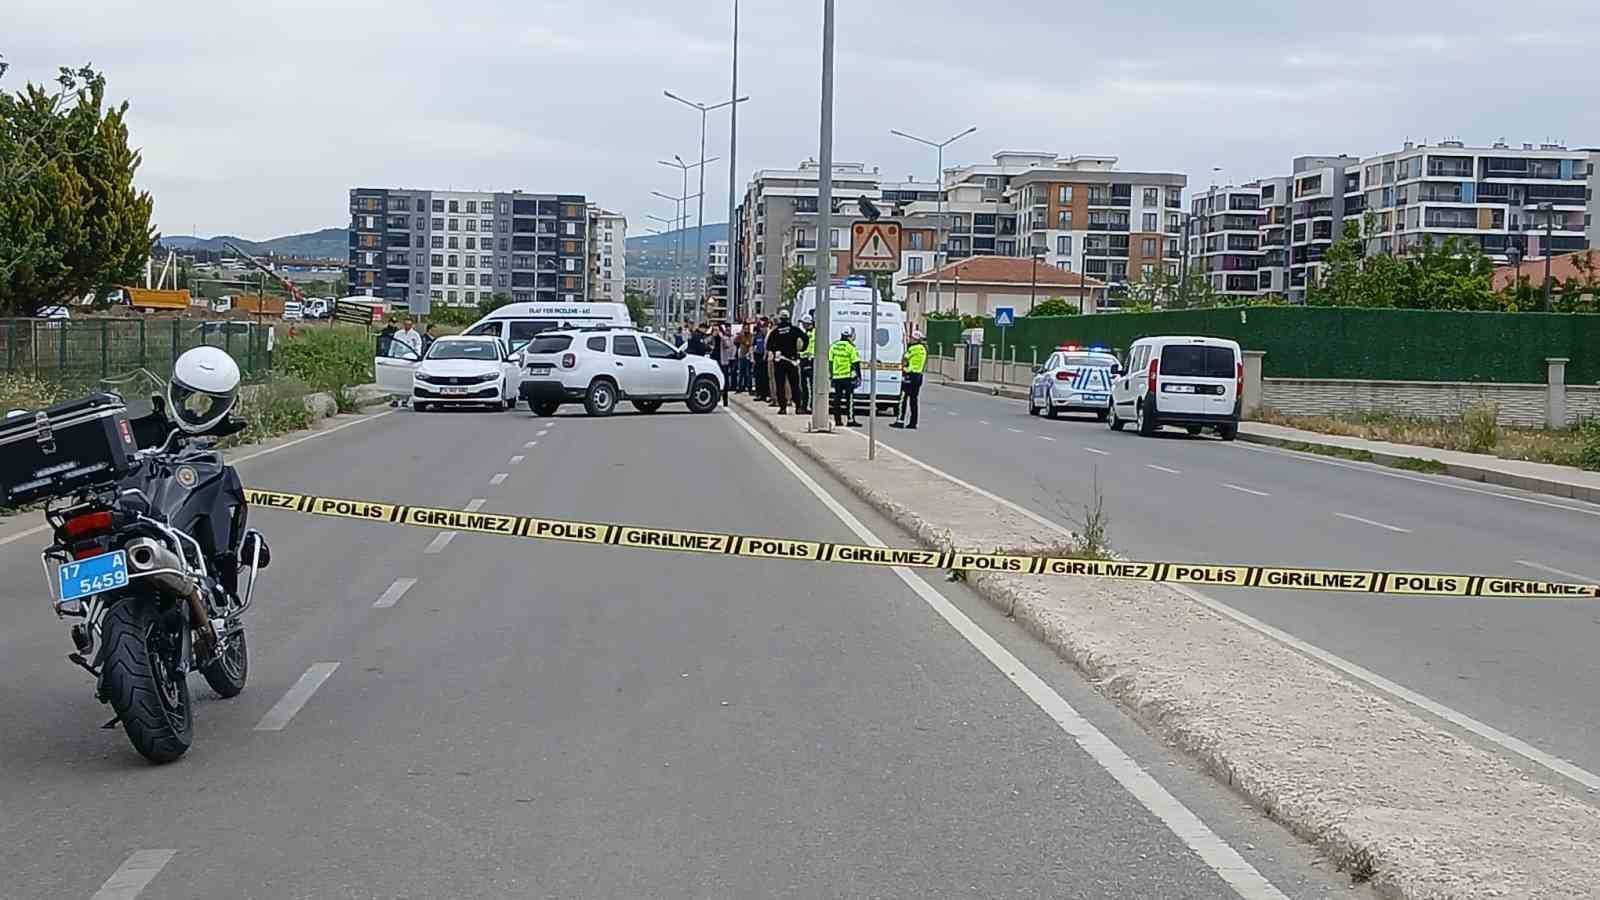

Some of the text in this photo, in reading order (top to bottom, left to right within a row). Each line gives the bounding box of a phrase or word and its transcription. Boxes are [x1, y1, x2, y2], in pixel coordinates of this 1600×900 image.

[245, 492, 295, 509] MEZ
[62, 554, 123, 580] 17 A
[80, 570, 125, 593] 5459
